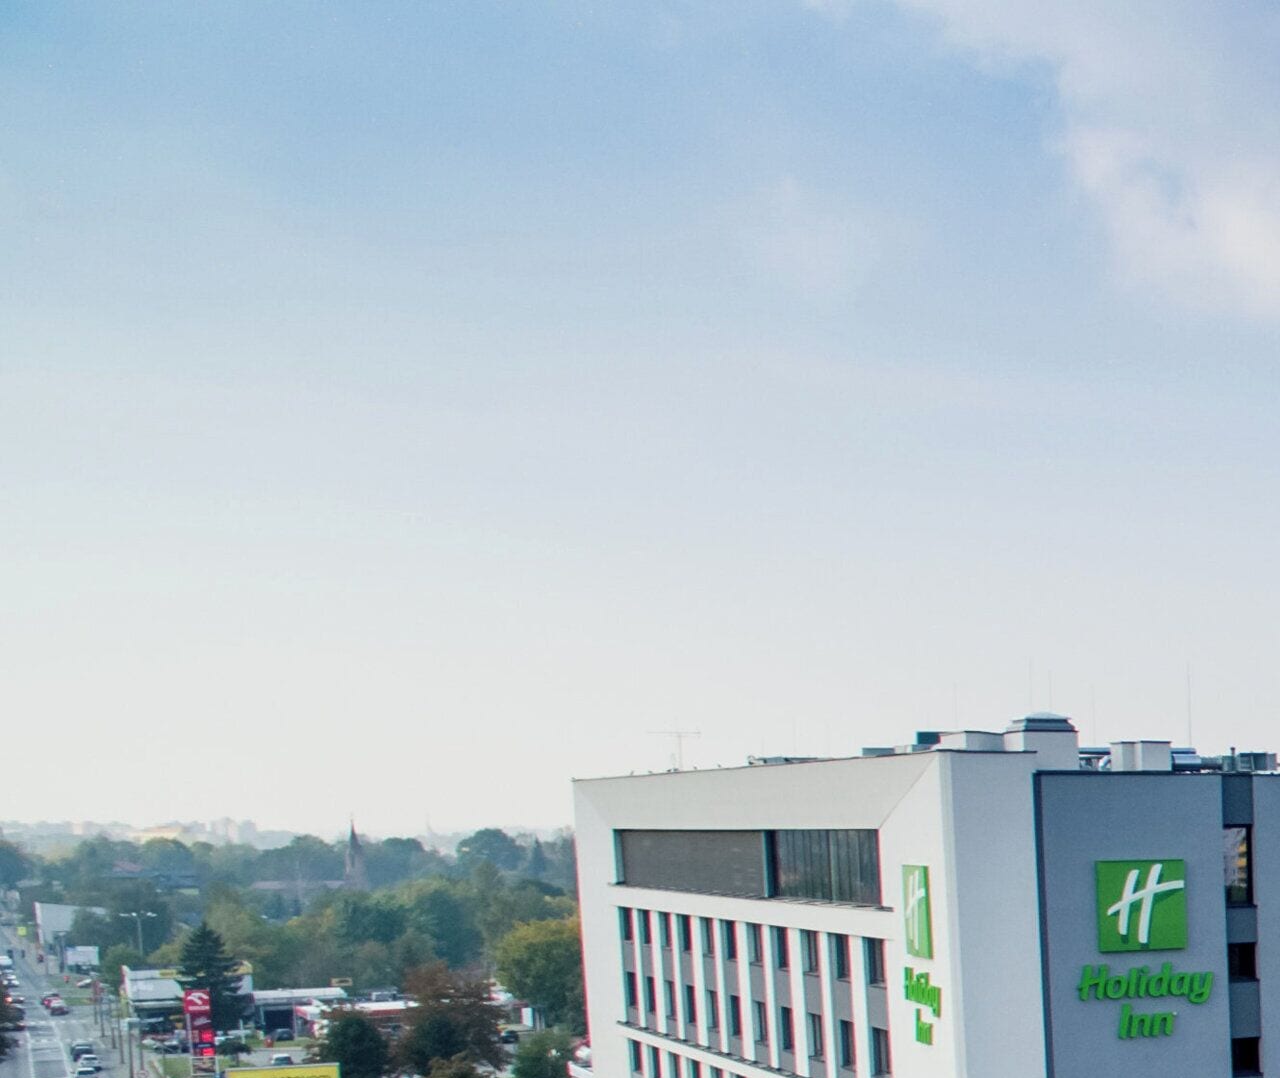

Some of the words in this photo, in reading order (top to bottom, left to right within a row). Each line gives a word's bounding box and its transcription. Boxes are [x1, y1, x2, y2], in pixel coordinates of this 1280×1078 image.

[903, 966, 941, 1019] Holiday
[1077, 962, 1214, 1005] Holiday
[915, 1008, 934, 1046] Inn
[1119, 1004, 1176, 1039] Inn
